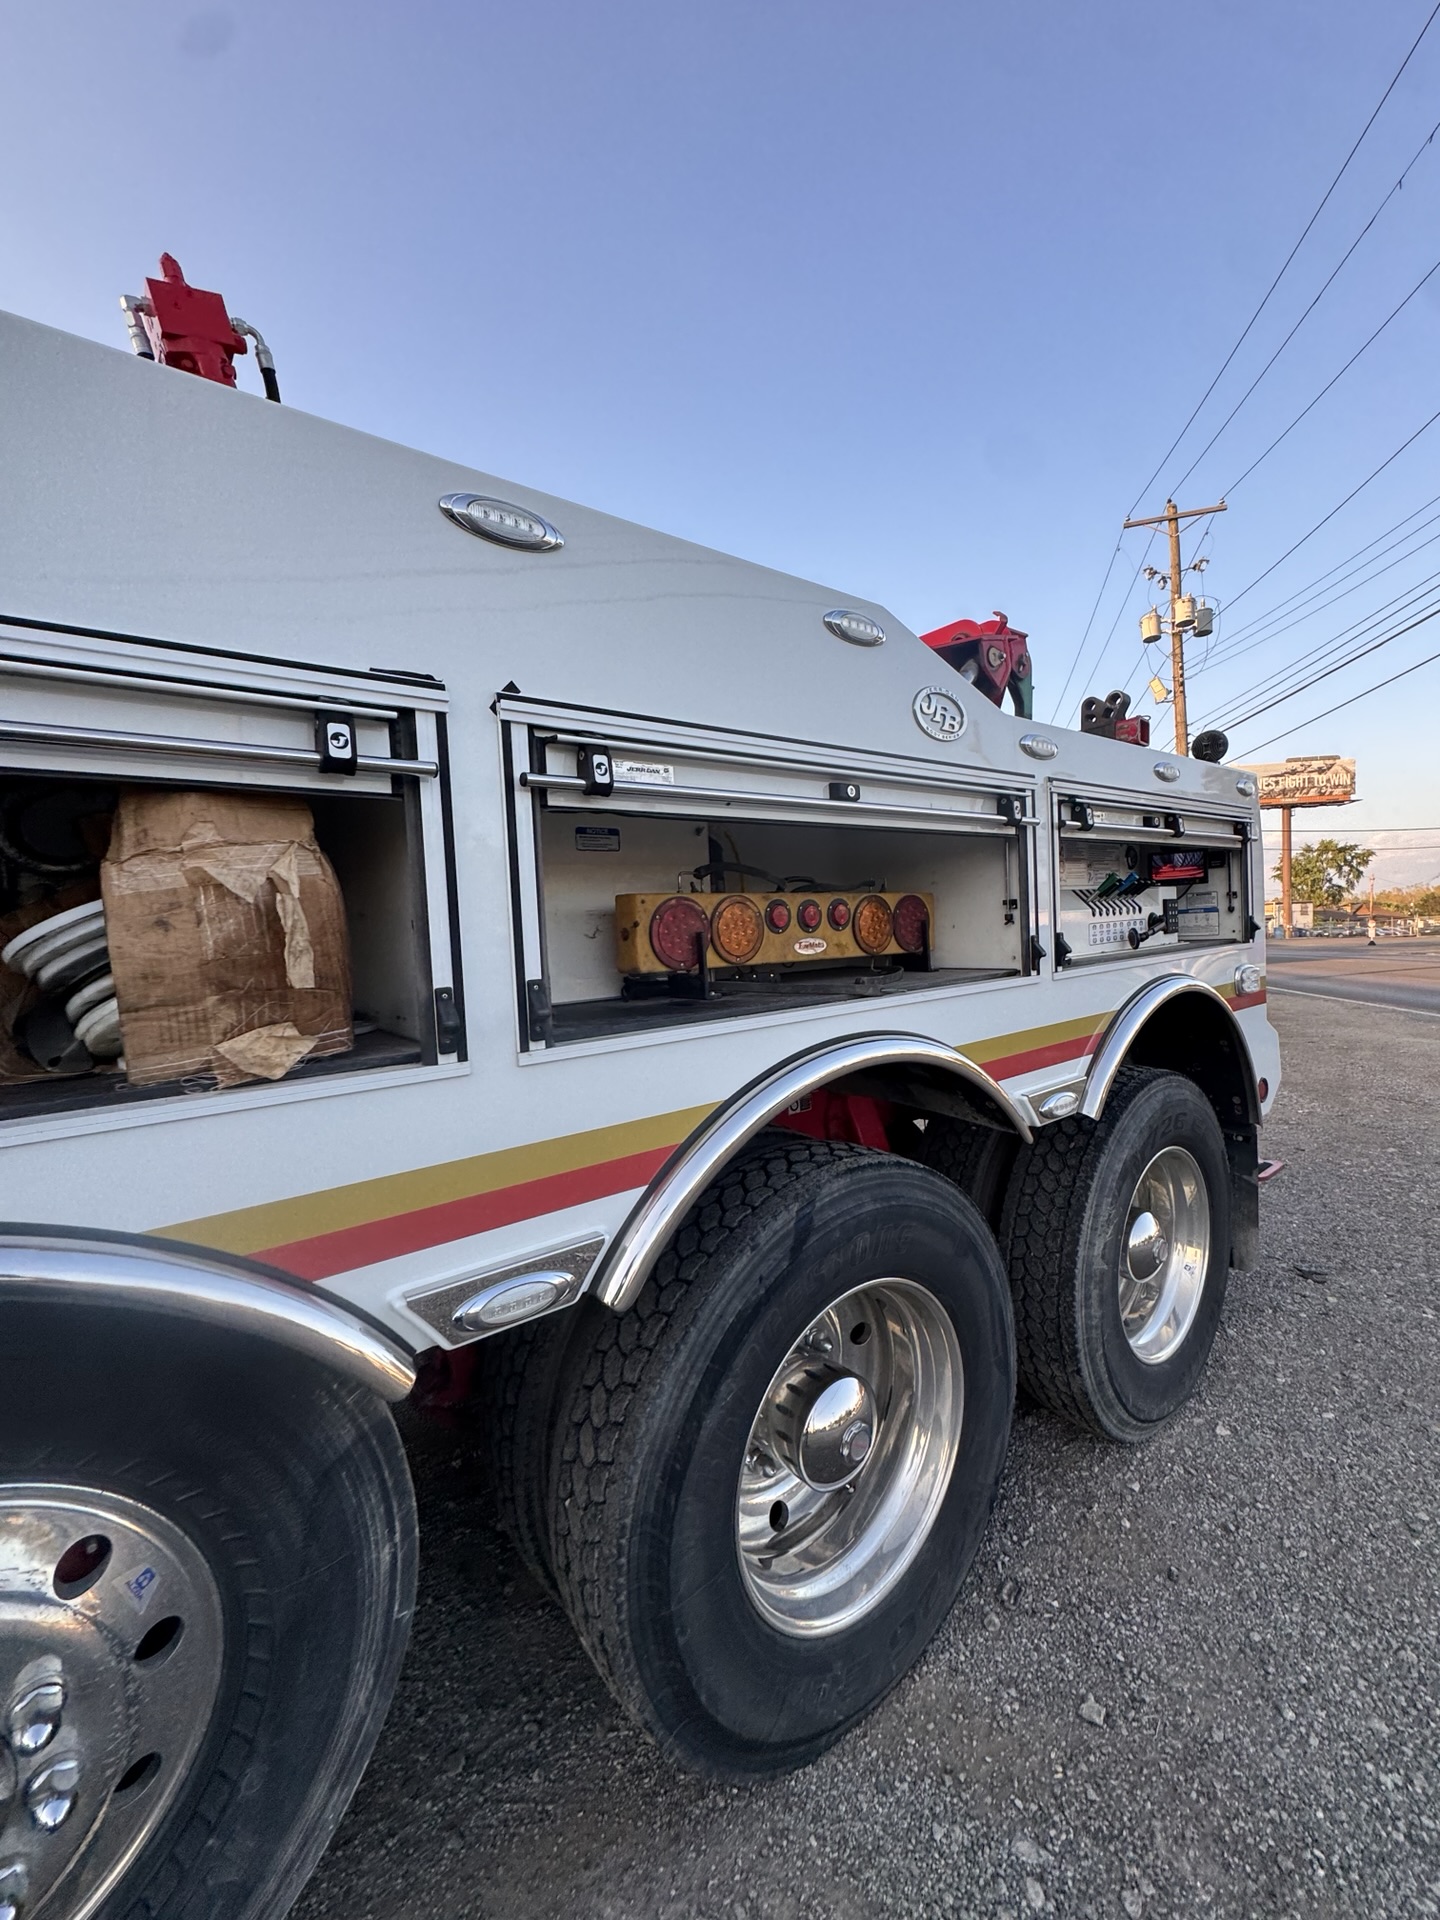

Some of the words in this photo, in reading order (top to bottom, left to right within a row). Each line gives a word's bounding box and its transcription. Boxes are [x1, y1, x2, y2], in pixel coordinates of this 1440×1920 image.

[919, 693, 962, 733] JFB
[1278, 775, 1309, 789] FIGHT
[1314, 775, 1325, 787] TO
[1329, 773, 1351, 786] WIN
